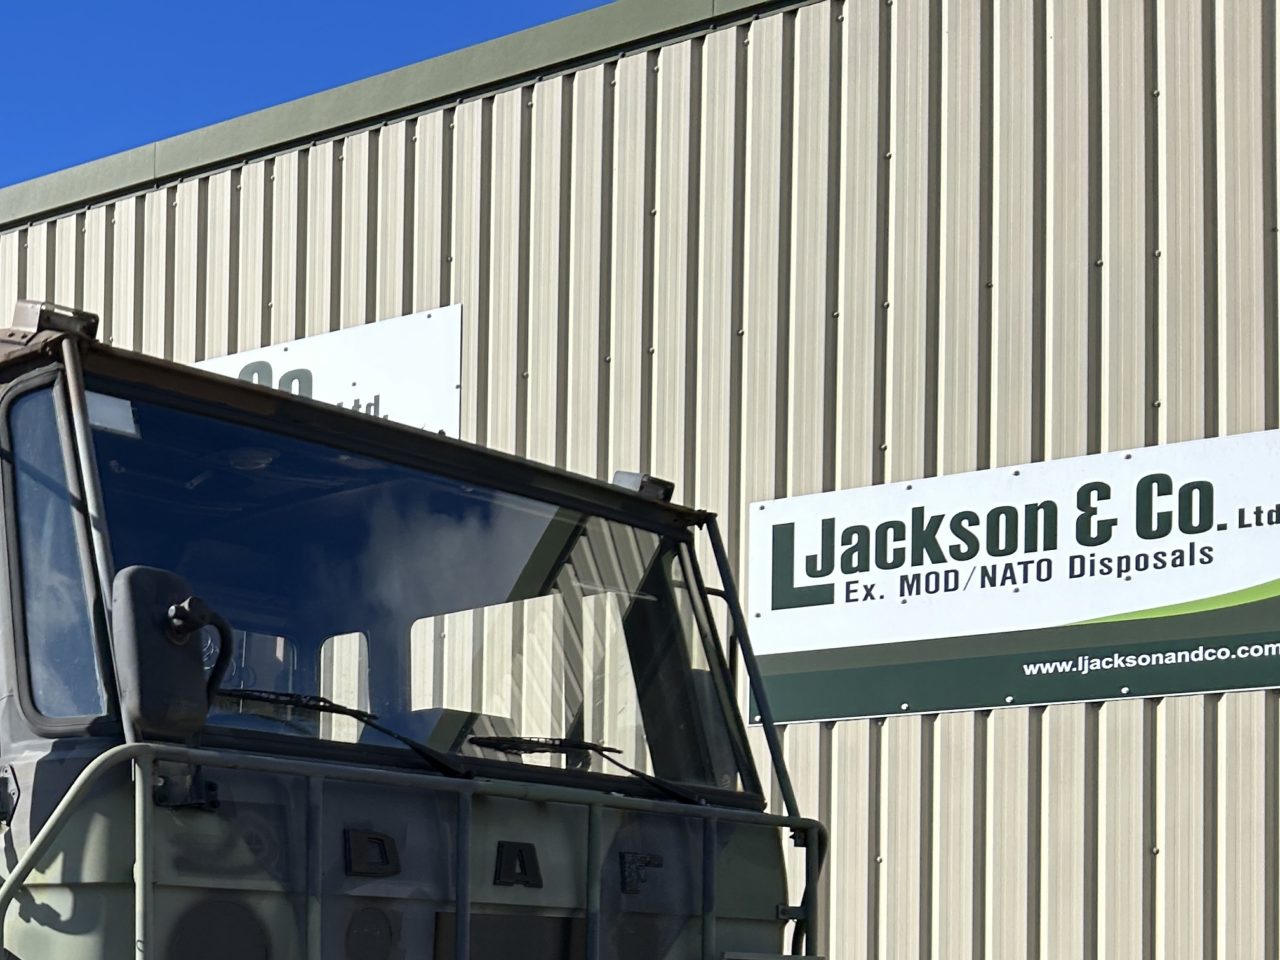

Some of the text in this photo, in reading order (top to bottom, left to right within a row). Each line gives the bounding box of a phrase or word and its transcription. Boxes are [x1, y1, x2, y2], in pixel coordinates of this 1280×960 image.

[1075, 481, 1118, 546] &
[1135, 473, 1227, 541] Co.
[845, 541, 1214, 603] Ex. MOD/NATO Disposals
